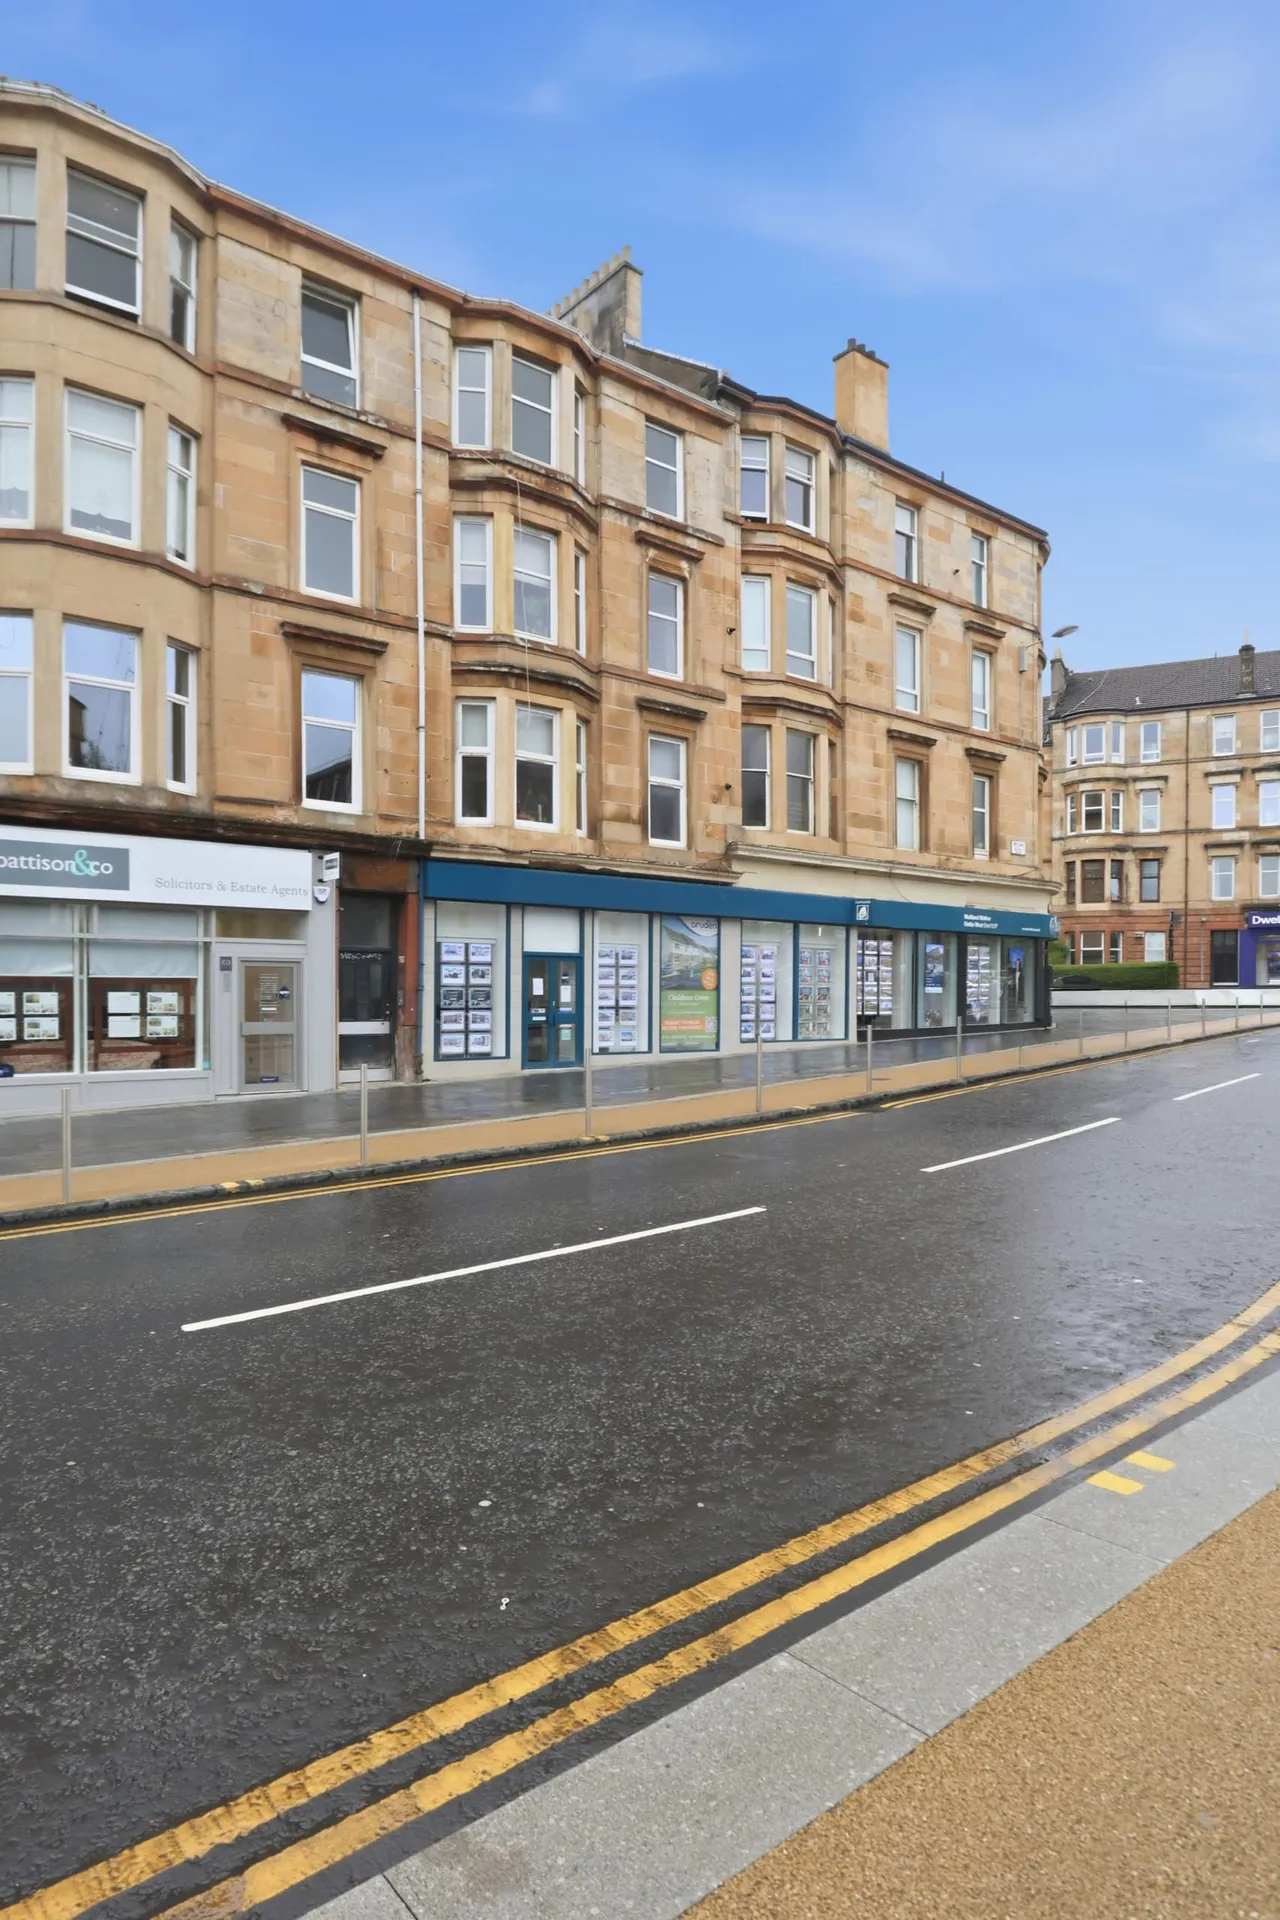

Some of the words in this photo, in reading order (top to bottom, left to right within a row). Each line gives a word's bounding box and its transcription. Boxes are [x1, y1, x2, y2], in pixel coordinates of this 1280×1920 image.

[155, 878, 212, 891] Solicitors
[217, 881, 227, 892] &
[231, 882, 267, 894] Estate
[271, 883, 308, 897] Agents
